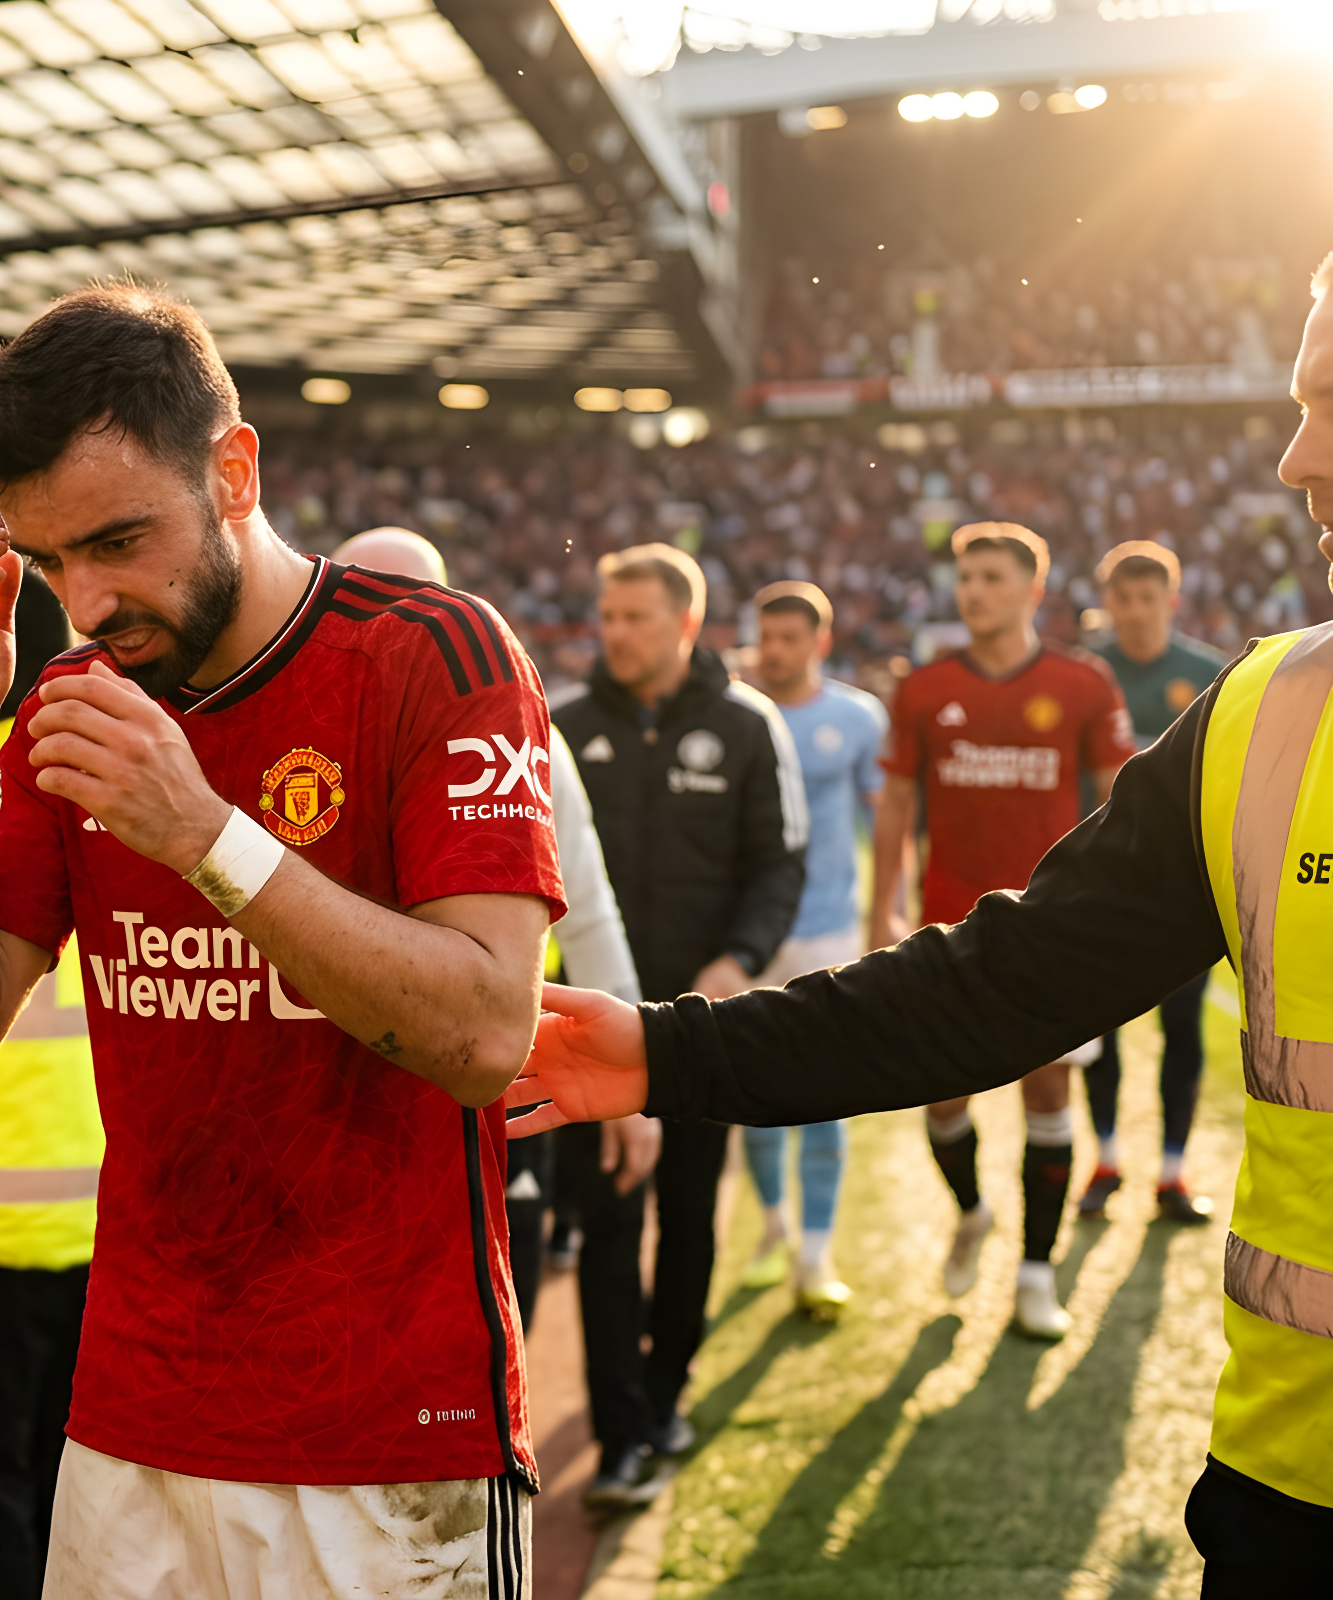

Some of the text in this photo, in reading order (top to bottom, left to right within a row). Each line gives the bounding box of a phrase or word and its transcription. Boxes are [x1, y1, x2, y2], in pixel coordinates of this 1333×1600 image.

[447, 734, 552, 810] DXC
[1296, 852, 1333, 884] SE
[112, 910, 260, 970] Team
[88, 954, 261, 1022] Viewer
